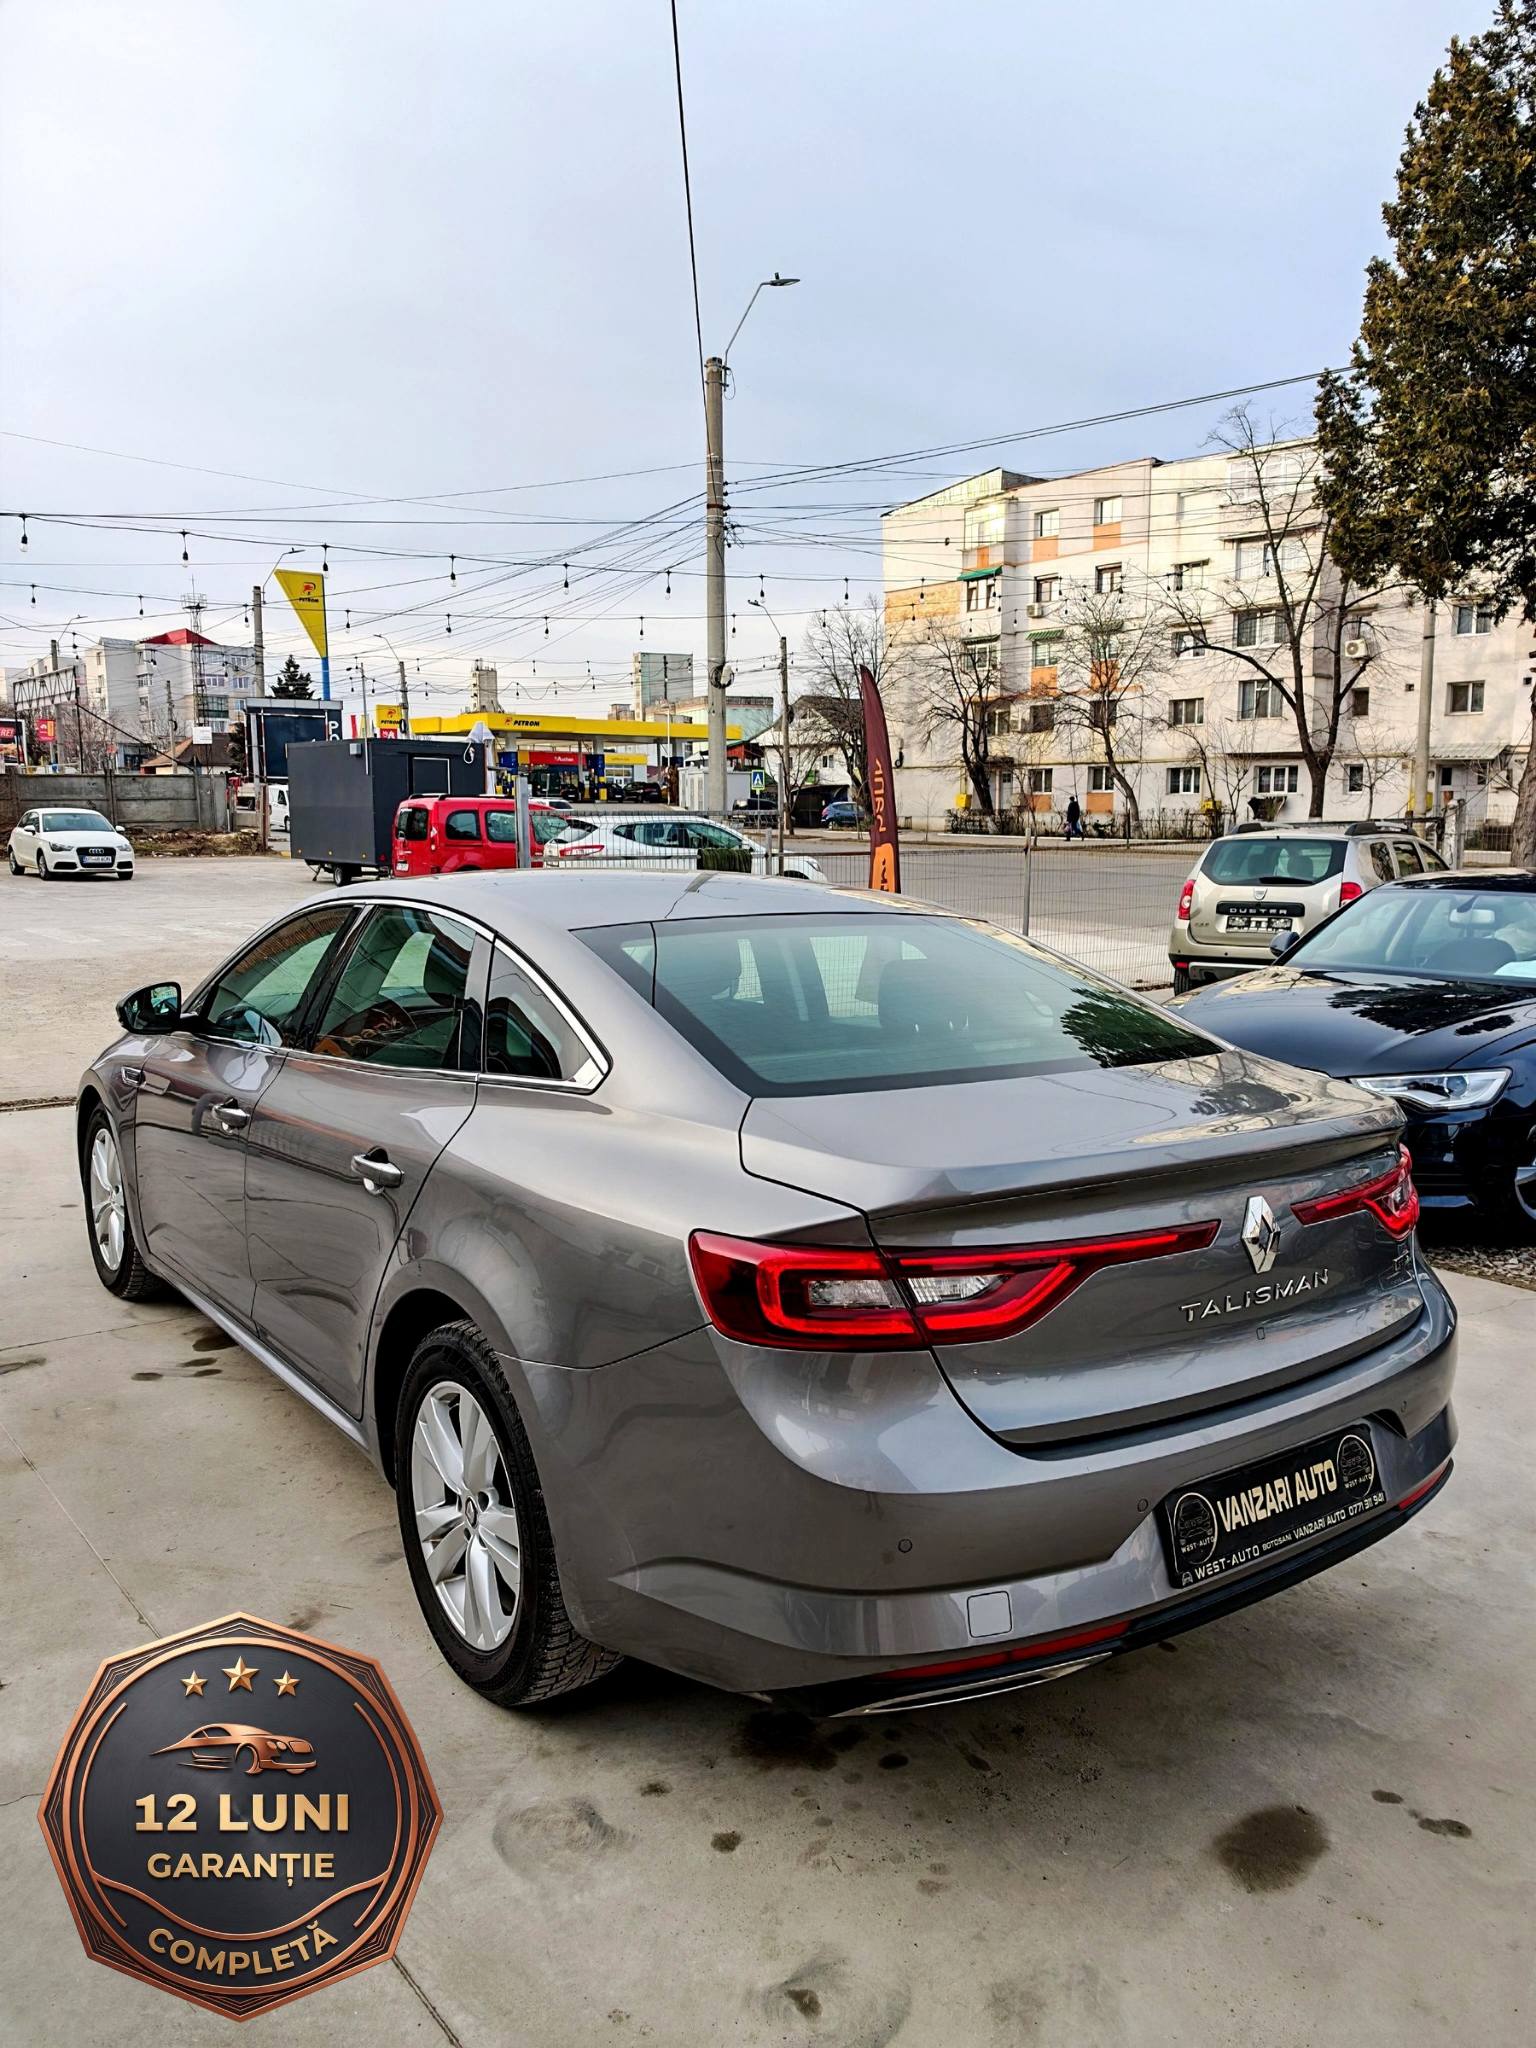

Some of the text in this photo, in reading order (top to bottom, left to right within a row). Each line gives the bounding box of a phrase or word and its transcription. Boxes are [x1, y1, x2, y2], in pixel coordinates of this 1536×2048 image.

[1229, 907, 1288, 915] DUSTER
[1180, 1269, 1329, 1322] TALISMAN
[1217, 1459, 1337, 1532] VANZARI AUTO
[1181, 1536, 1215, 1553] WEST-AUTO
[1195, 1545, 1260, 1580] WEST-AUTO
[1293, 1516, 1326, 1539] VANZARI
[1326, 1509, 1346, 1525] AUTO
